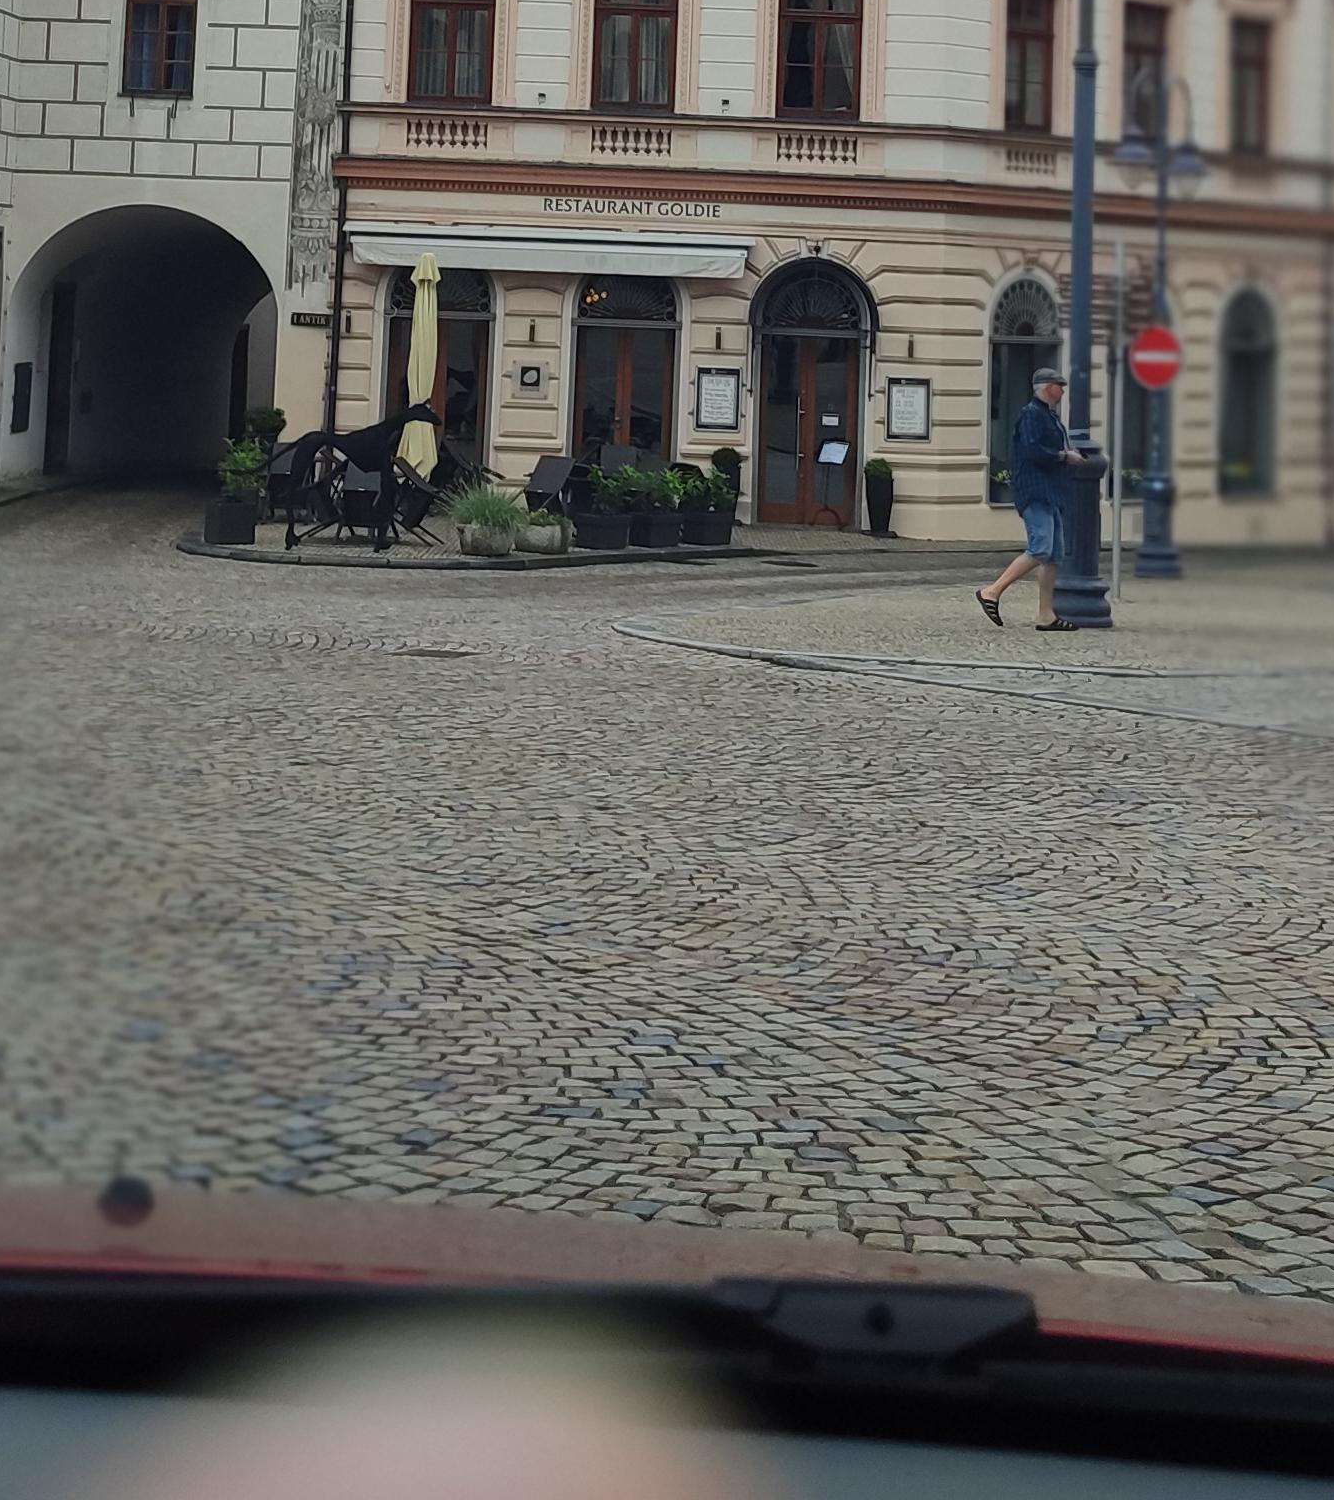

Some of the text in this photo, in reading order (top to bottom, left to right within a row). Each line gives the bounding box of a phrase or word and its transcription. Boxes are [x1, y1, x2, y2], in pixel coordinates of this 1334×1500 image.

[543, 198, 721, 218] RESTAURANT GOLDIE
[299, 314, 326, 325] ANTIK
